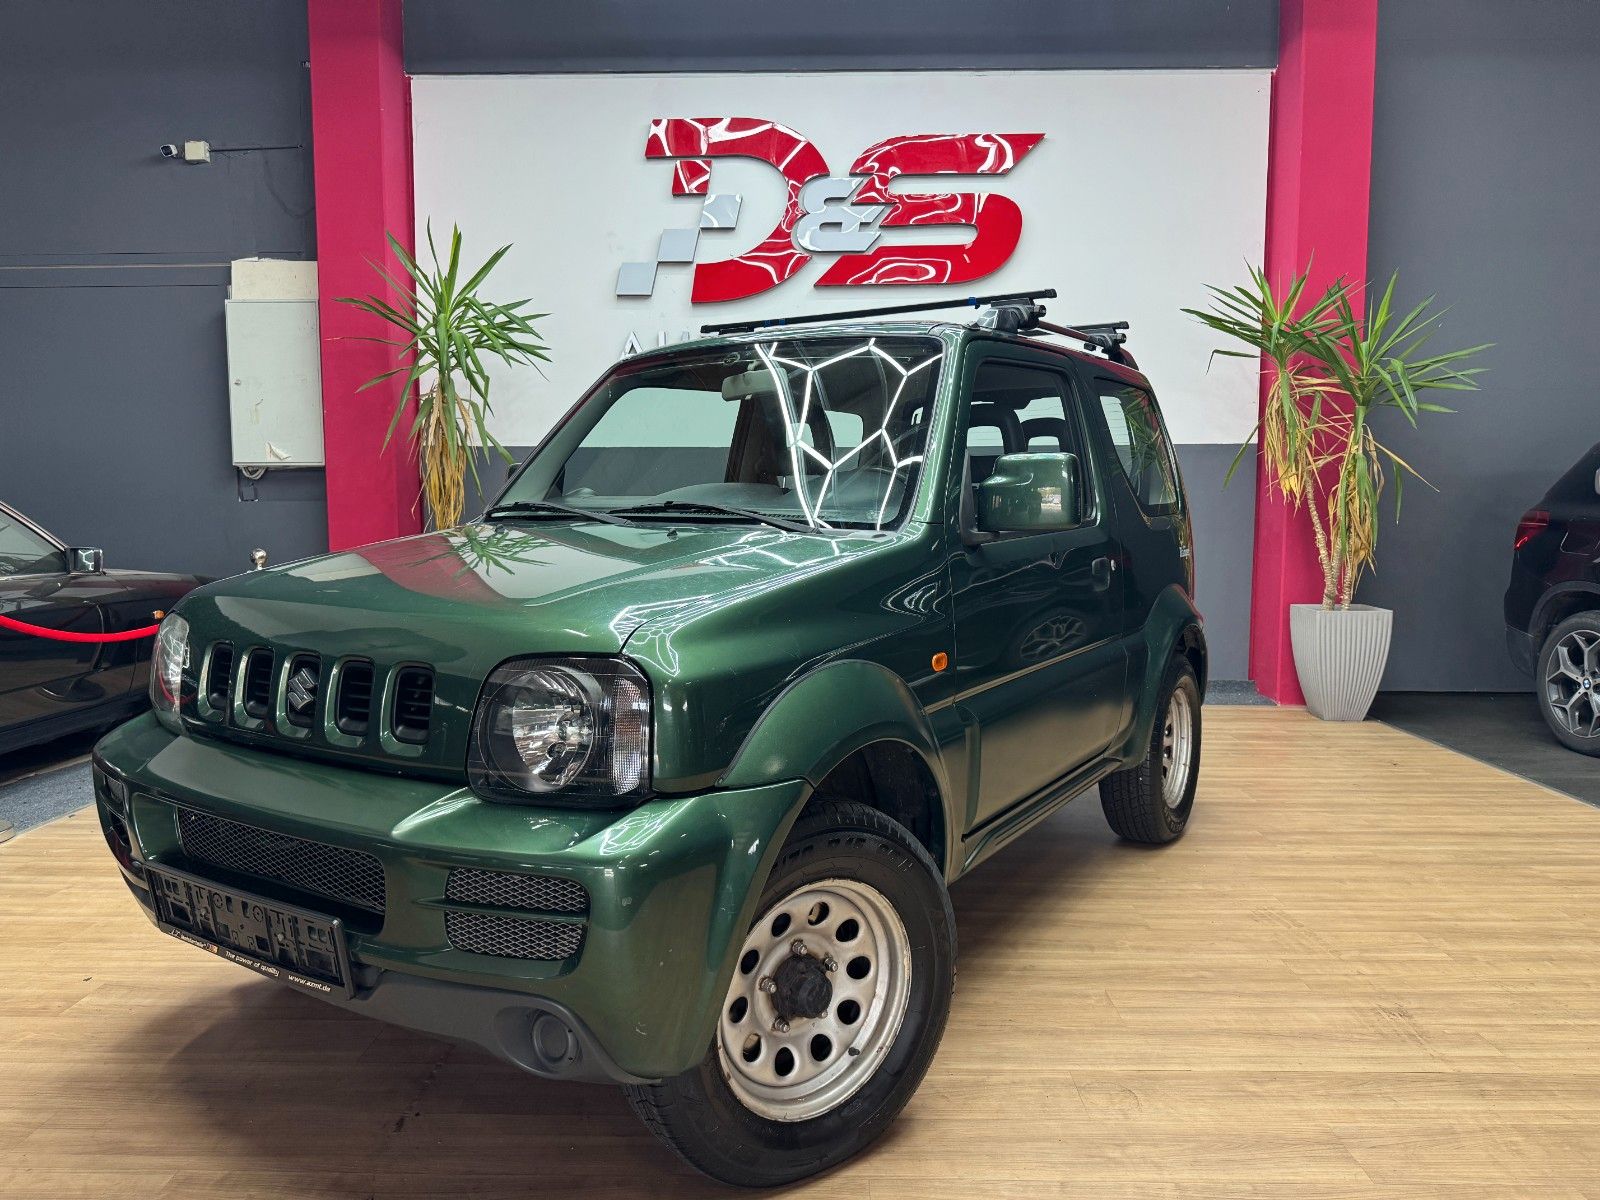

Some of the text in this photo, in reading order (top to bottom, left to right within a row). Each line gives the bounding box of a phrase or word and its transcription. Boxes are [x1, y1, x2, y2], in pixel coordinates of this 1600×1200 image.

[616, 117, 1046, 304] D&S
[225, 950, 235, 960] The
[235, 955, 253, 966] power
[260, 965, 280, 977] quality
